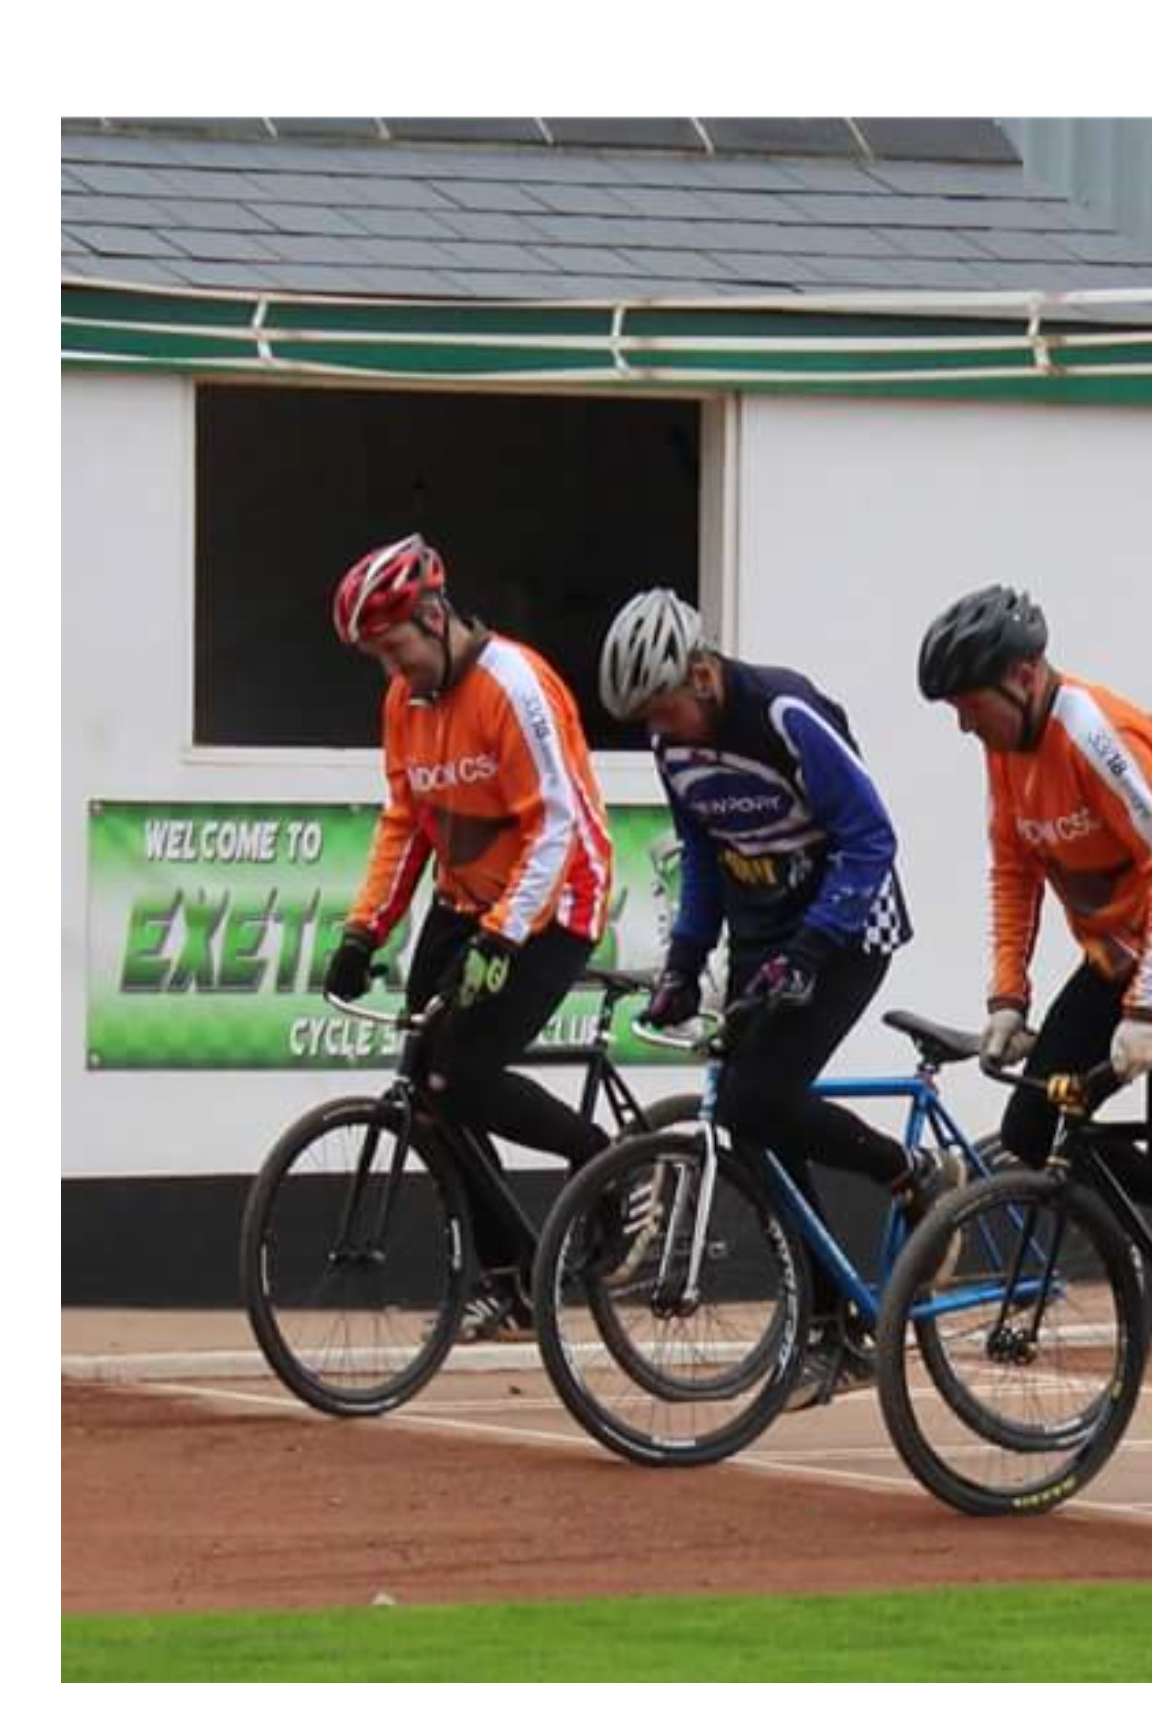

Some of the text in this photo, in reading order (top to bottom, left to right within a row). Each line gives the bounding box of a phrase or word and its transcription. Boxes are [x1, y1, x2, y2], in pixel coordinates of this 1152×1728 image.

[145, 818, 323, 863] WELCOME TO
[289, 1017, 374, 1058] CYCLE
